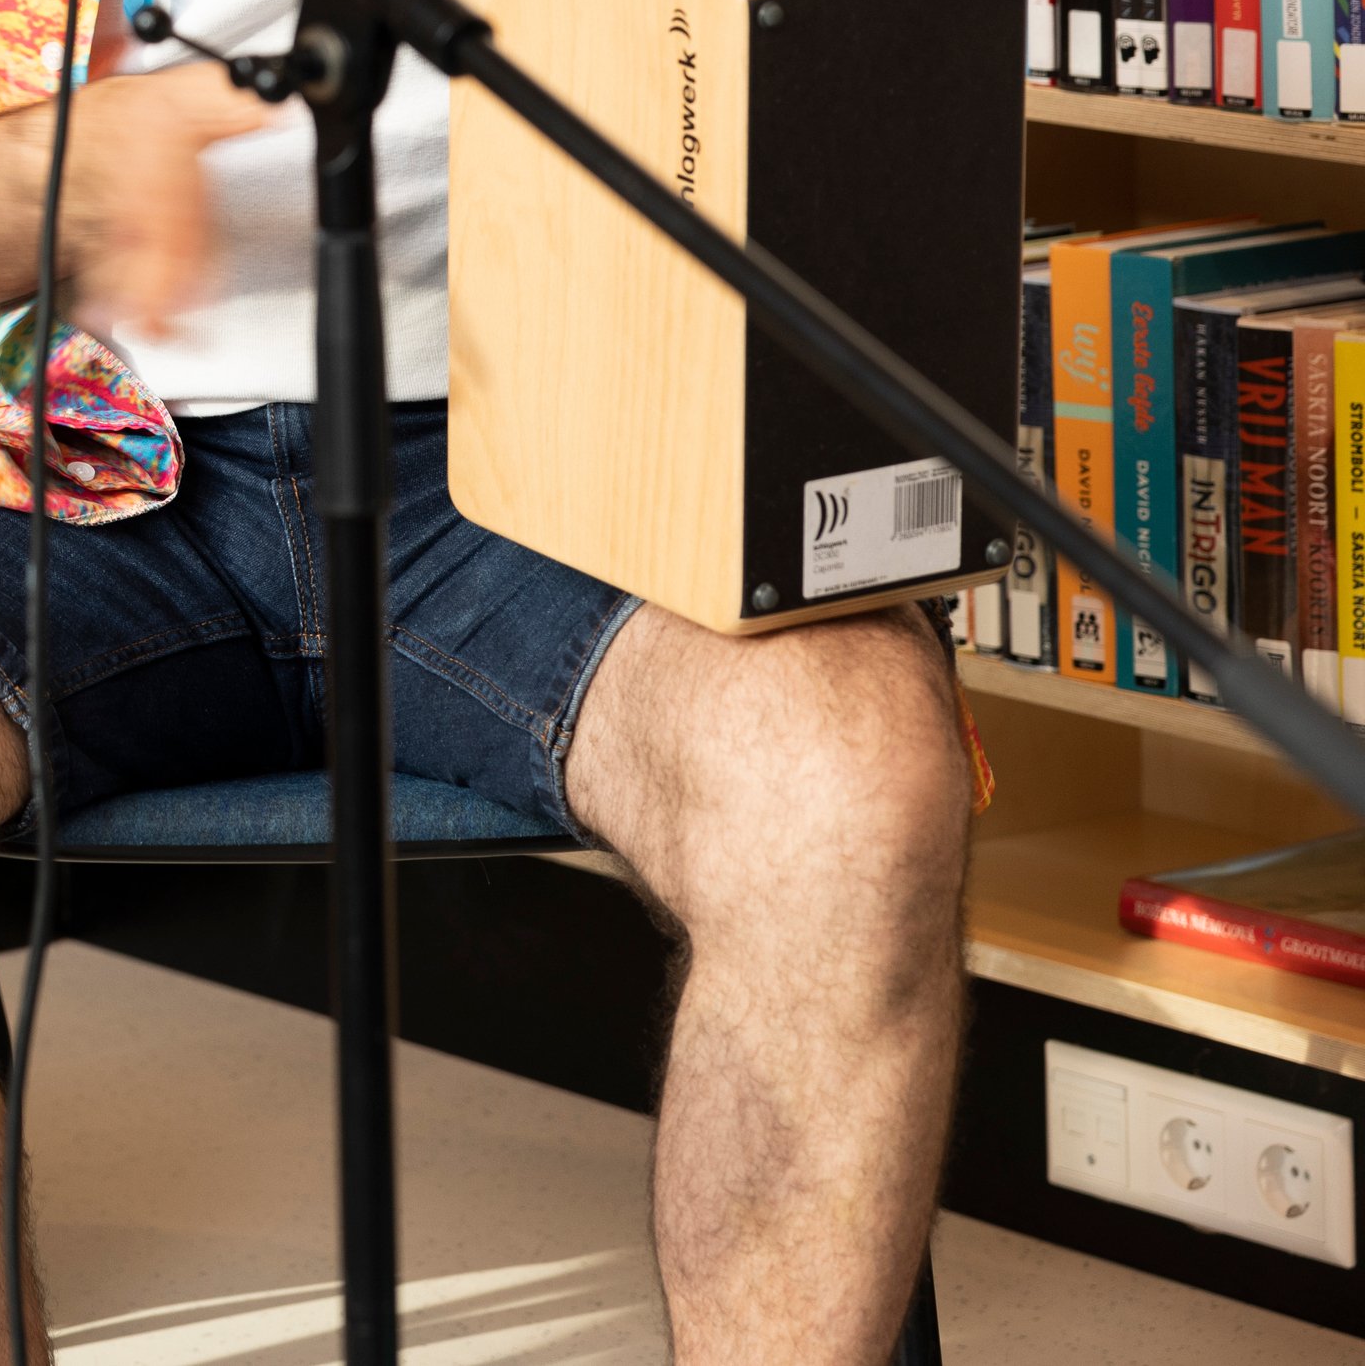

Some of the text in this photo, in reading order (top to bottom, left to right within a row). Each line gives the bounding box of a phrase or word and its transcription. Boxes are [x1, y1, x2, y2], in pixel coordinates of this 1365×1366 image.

[676, 50, 701, 210] hlagwerk
[1057, 323, 1108, 392] wij
[1127, 301, 1156, 519] Eerste liefde DAVID
[1237, 356, 1288, 557] VRIJ MAN
[1077, 449, 1092, 510] DAVID
[1186, 324, 1221, 615] HÅKAN NESSER INTRIGO
[1306, 352, 1330, 635] SASKIA NOORT KOORTS
[1350, 402, 1365, 650] STROMBOLI SASKIA NOORT
[1280, 936, 1365, 972] GROOTMOE
